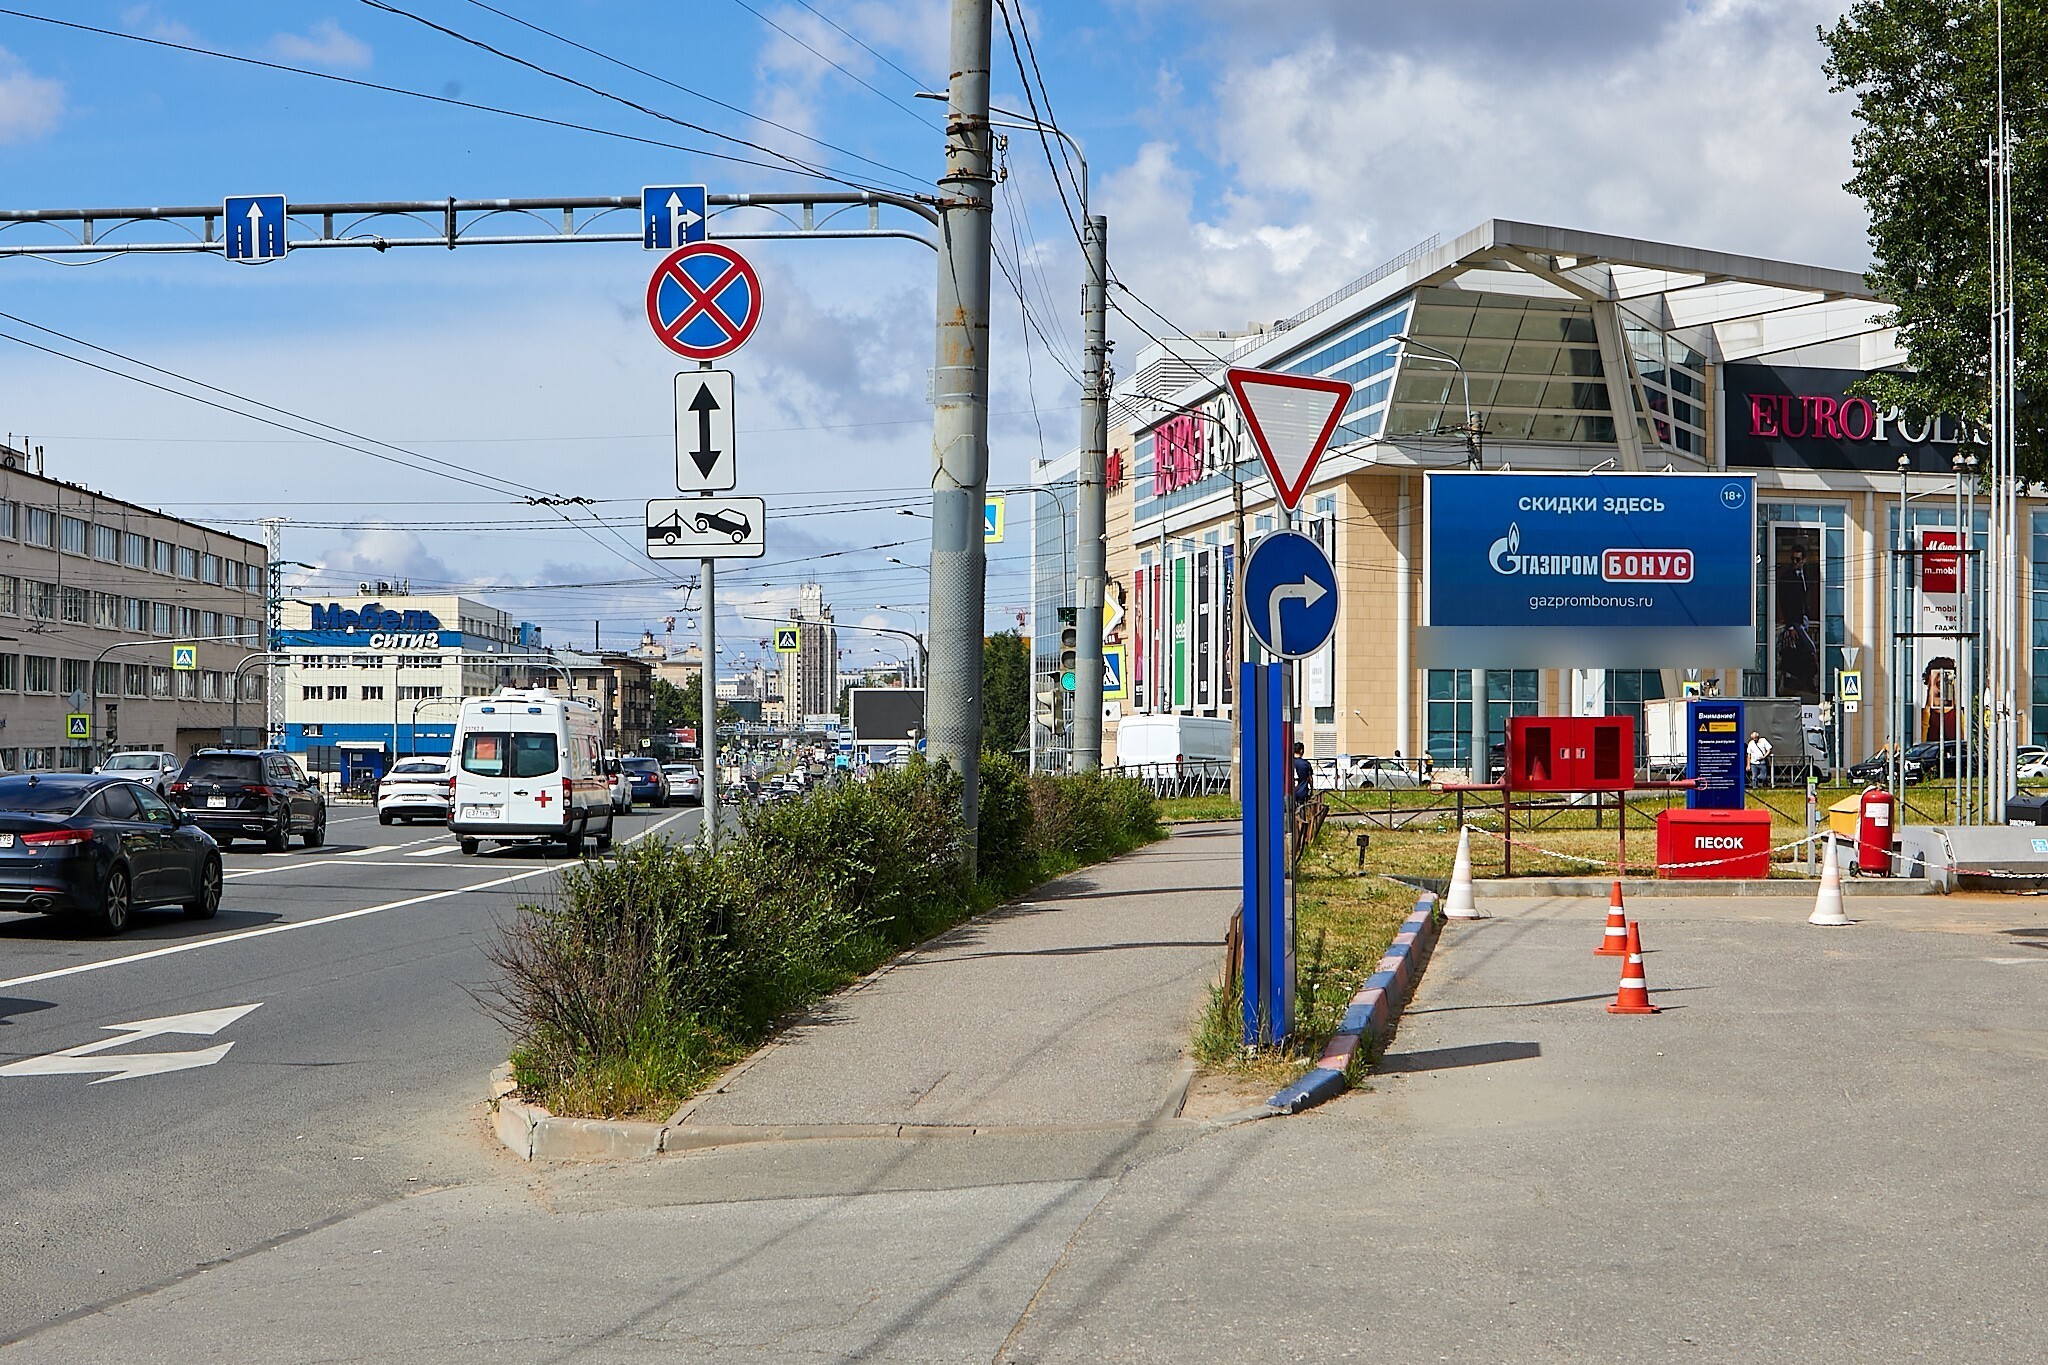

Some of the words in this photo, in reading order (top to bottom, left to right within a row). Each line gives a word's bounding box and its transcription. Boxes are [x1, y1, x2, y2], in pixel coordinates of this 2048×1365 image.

[1749, 393, 1990, 445] EUROPOL
[1723, 490, 1742, 501] 18+
[1518, 496, 1597, 513] СКИДКИ
[1603, 496, 1665, 513] ЗДЕСЬ
[1521, 554, 1598, 576] ГАЗПРОМ
[1608, 555, 1687, 576] БОНУС
[1529, 594, 1653, 610] gazprombonus.ru
[312, 603, 439, 630] Мебель
[1698, 712, 1736, 720] Внимание!
[1694, 836, 1744, 849] ПЕСОК
